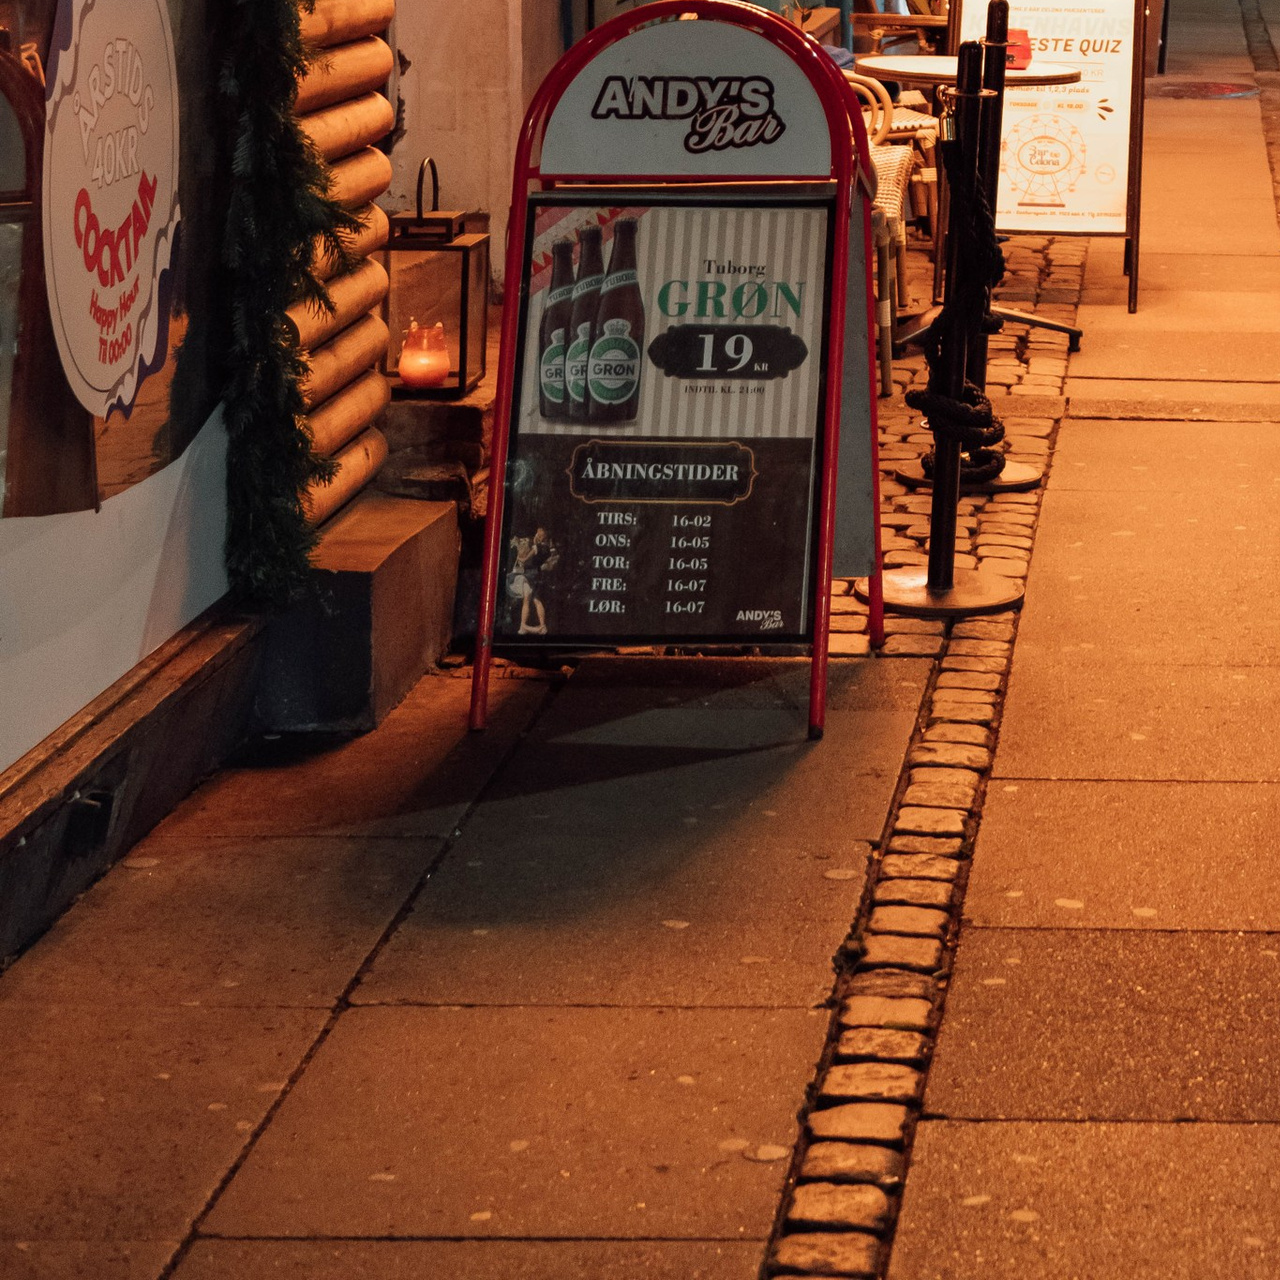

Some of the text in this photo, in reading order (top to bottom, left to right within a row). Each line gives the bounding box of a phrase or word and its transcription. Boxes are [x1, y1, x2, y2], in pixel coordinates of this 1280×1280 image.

[1079, 38, 1124, 57] QUIZ
[1091, 68, 1105, 77] KR
[594, 78, 772, 118] ANDY'S
[1067, 86, 1090, 95] plads
[73, 37, 155, 166] ÅRSTIDS
[686, 104, 782, 151] Bar
[703, 259, 767, 277] Tuborg
[89, 273, 140, 336] Happy Hour
[657, 279, 806, 322] GRØN
[108, 322, 133, 366] 00:00
[696, 333, 769, 372] 19 KR
[545, 367, 564, 379] GR
[592, 363, 636, 376] GRØN
[581, 456, 739, 481] ÅBNINGSTIDER
[597, 511, 712, 527] TIRS: 16-02
[595, 533, 710, 549] ONS: 16-05
[592, 555, 708, 570] TOR: 16-05
[591, 577, 707, 592] FRE: 16-07
[588, 599, 706, 614] LØR: 16-07
[735, 609, 782, 621] ANDY'S
[759, 618, 785, 631] Bar
